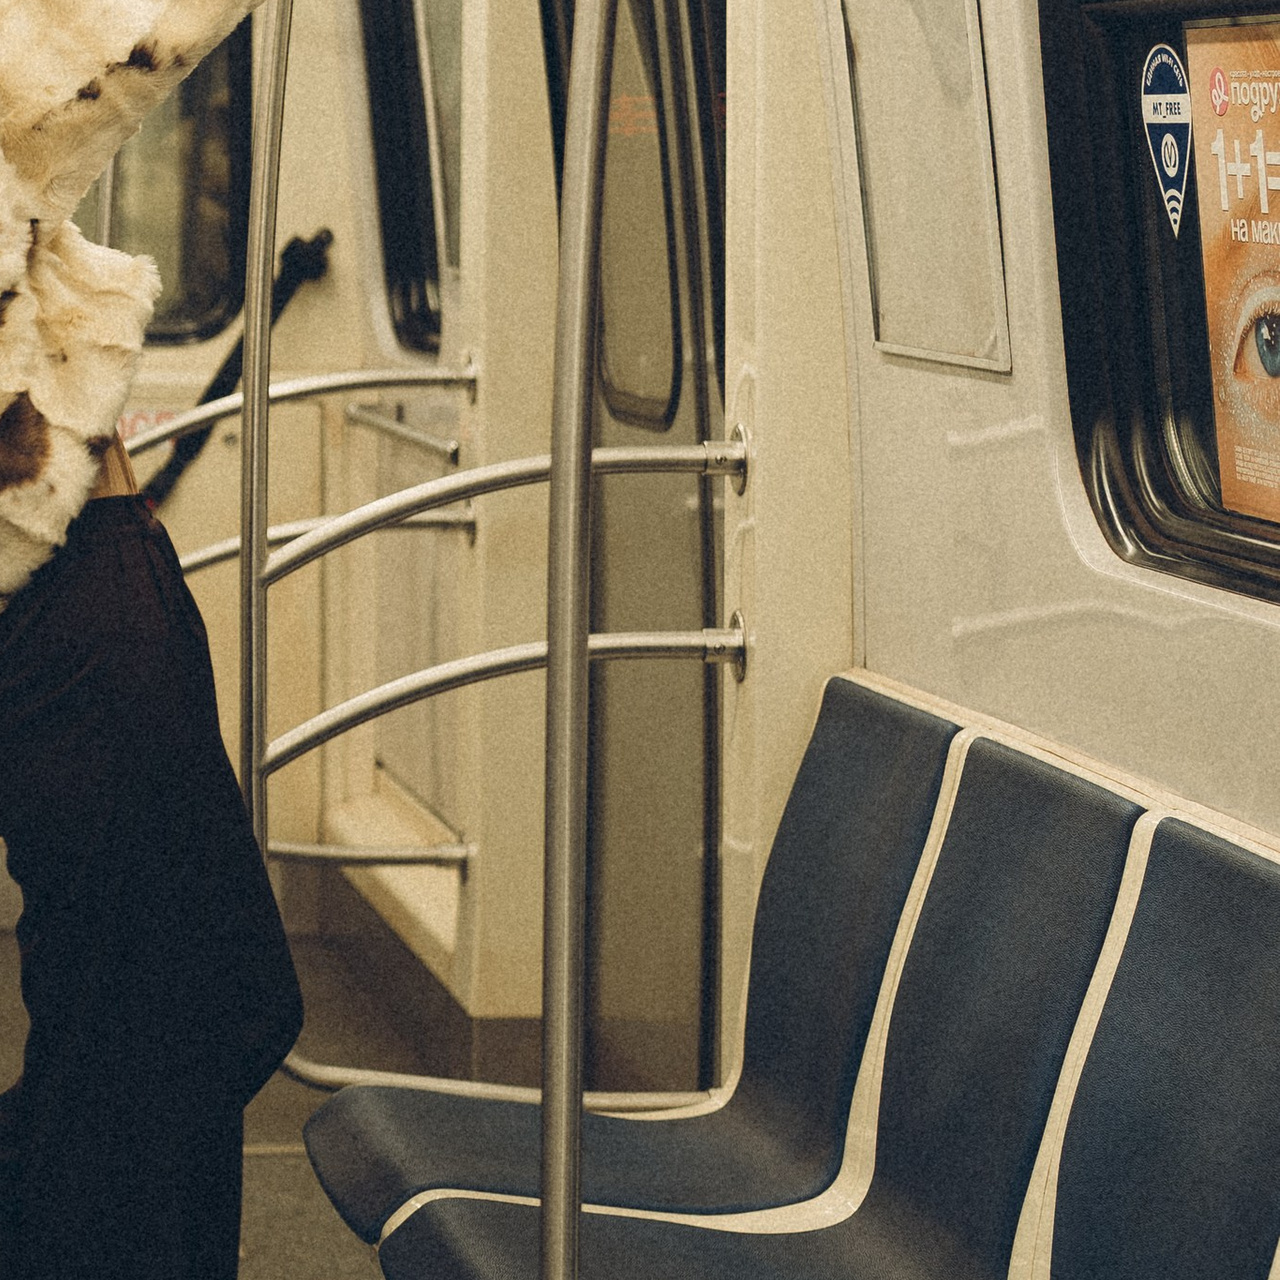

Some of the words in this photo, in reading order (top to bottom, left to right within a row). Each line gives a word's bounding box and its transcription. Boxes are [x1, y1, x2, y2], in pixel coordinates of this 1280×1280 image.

[1152, 102, 1181, 118] MT_FREE
[1231, 81, 1280, 123] подру
[1230, 218, 1249, 242] на
[1251, 219, 1280, 245] мак
